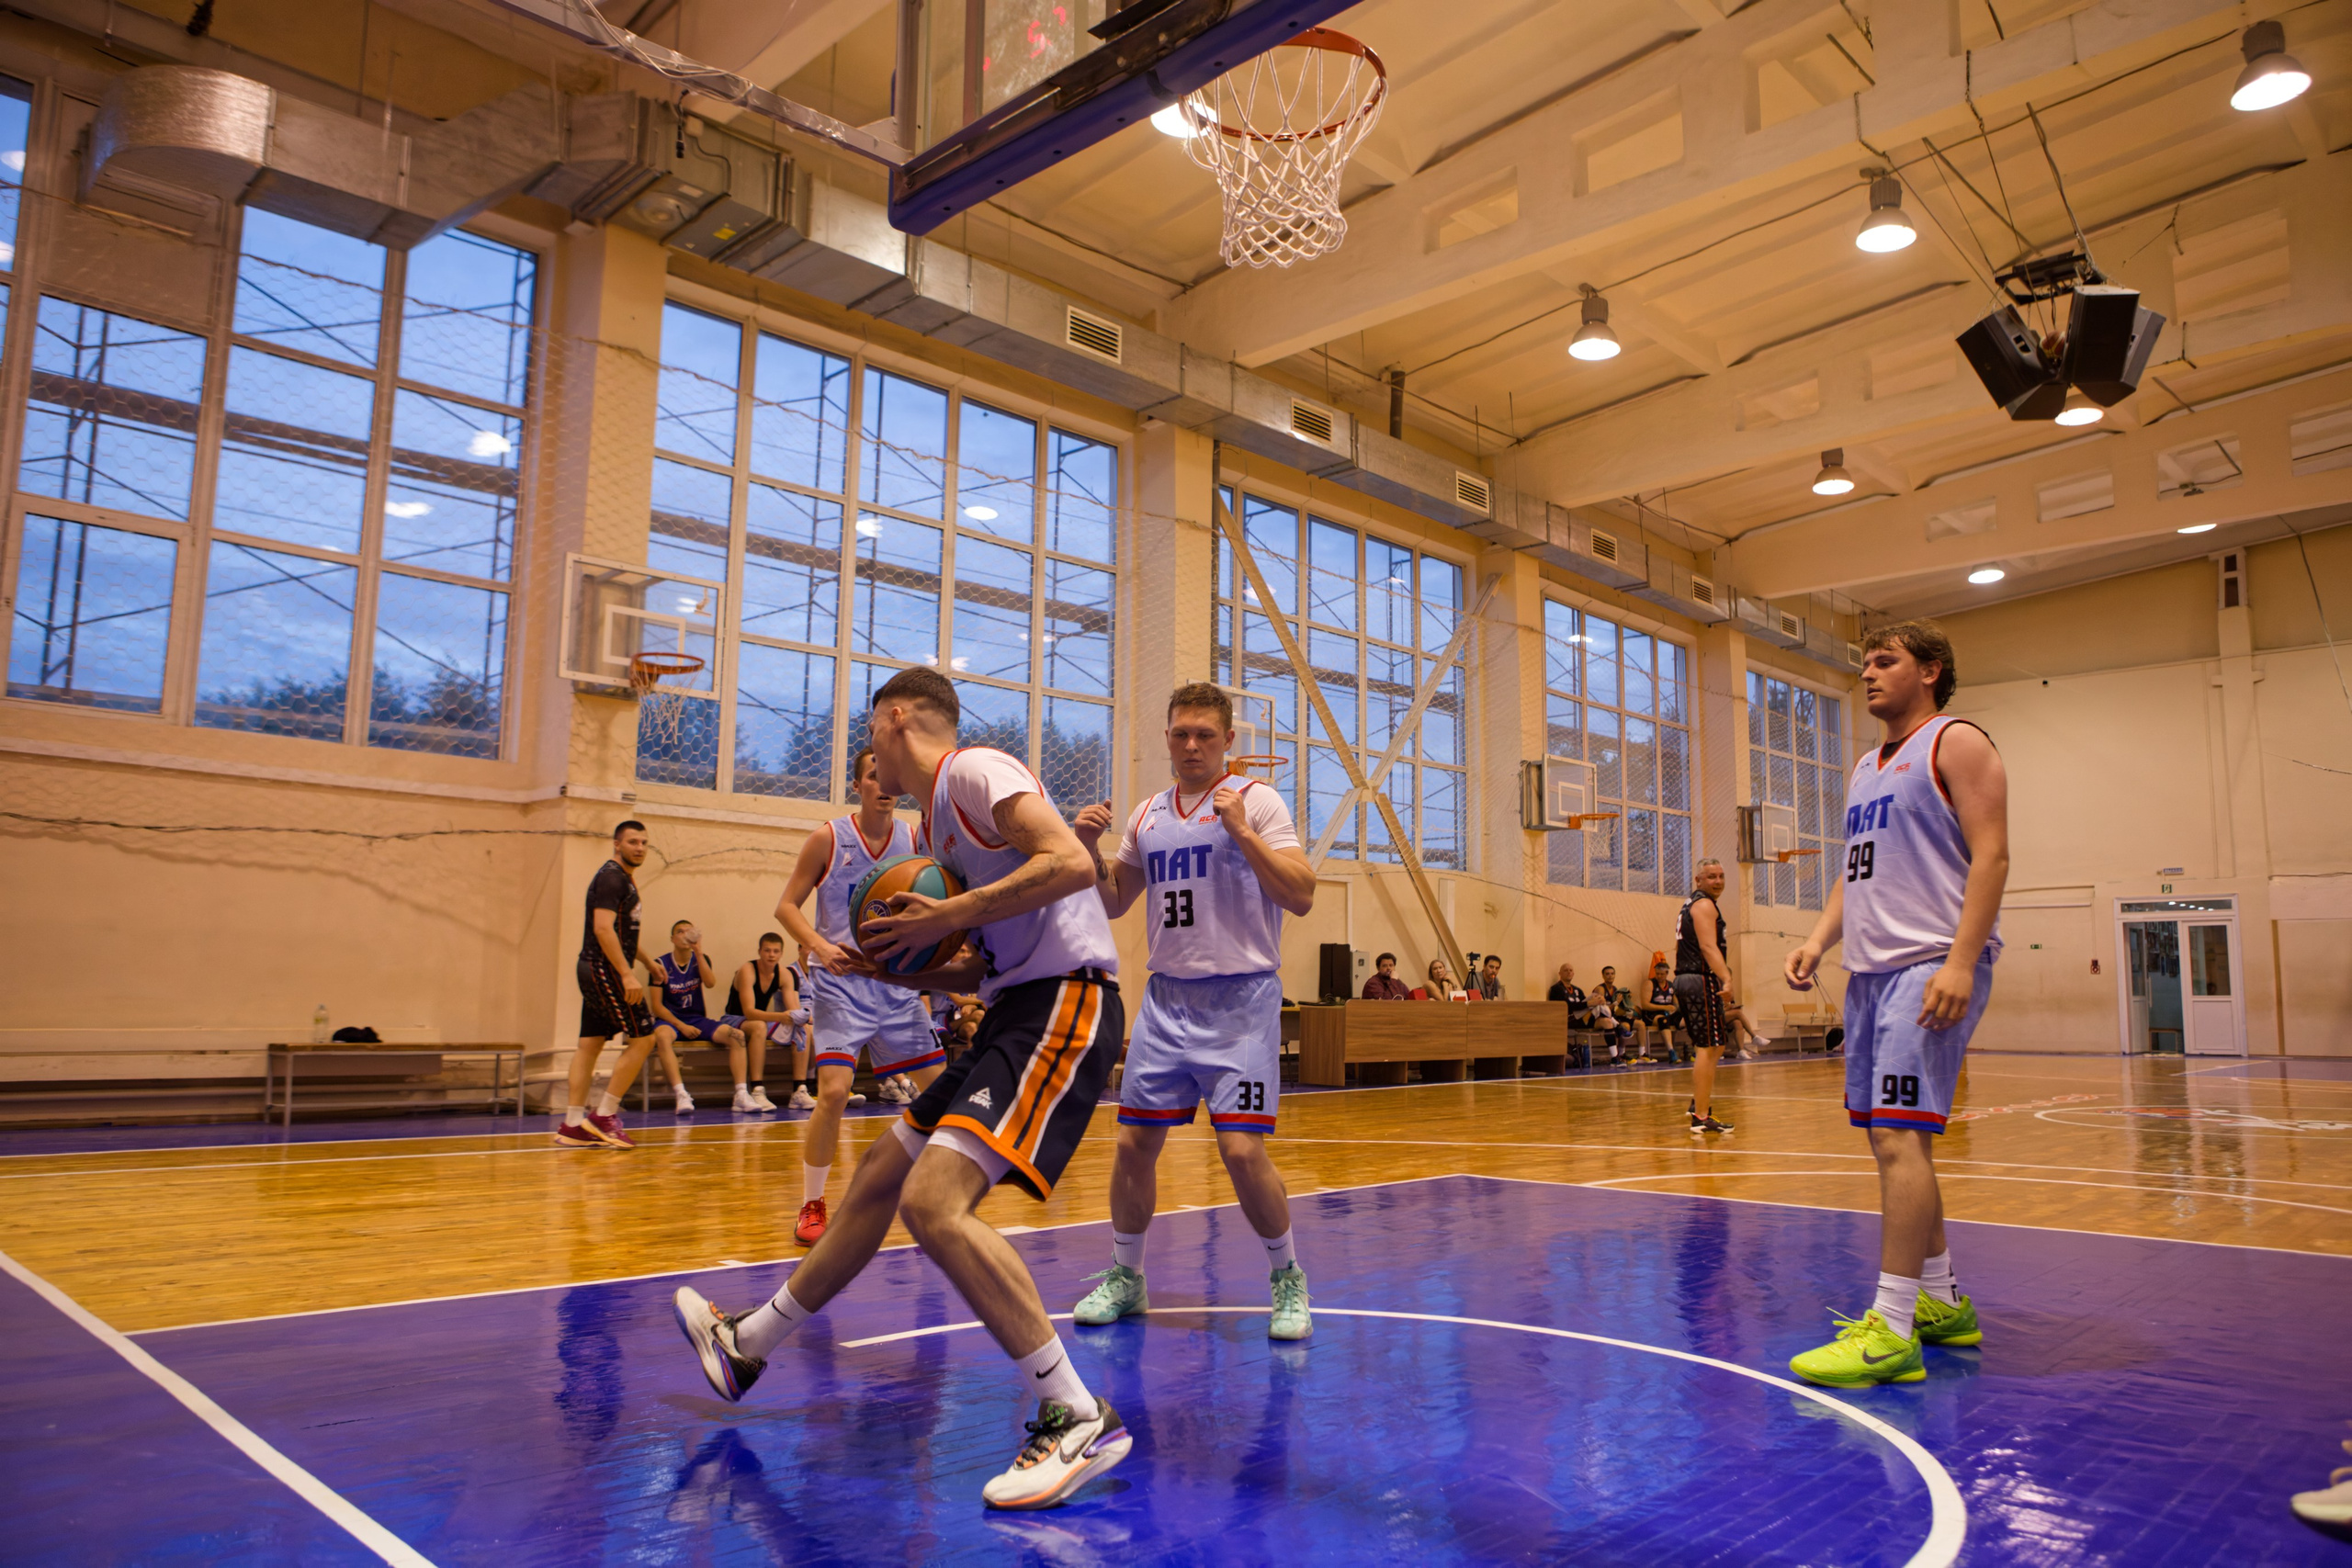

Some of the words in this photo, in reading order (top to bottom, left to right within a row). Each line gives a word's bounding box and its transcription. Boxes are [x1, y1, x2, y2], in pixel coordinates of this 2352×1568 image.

[1847, 794, 1894, 838] ПАТ
[1148, 844, 1213, 885] ПАТ
[1848, 840, 1875, 883] 99
[1163, 889, 1194, 929] 33
[681, 994, 693, 1009] 21
[968, 1094, 992, 1110] PEAK
[1238, 1081, 1265, 1111] 33
[1882, 1074, 1918, 1107] 99
